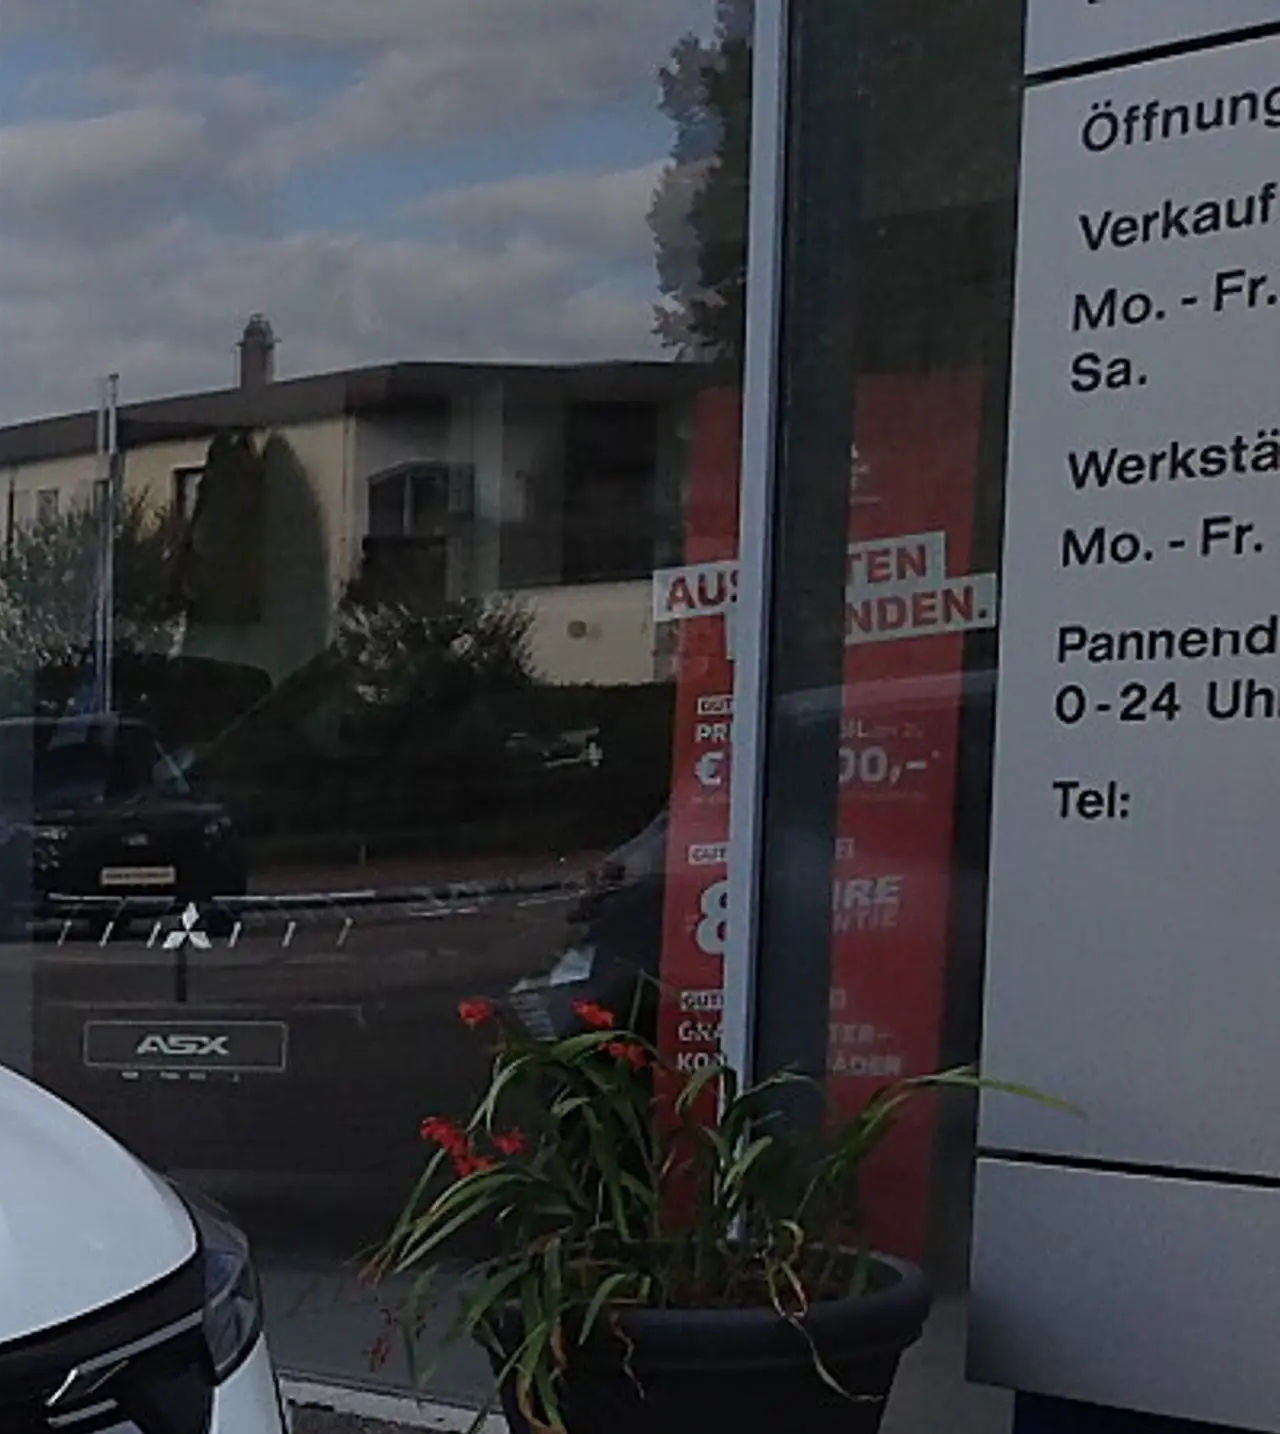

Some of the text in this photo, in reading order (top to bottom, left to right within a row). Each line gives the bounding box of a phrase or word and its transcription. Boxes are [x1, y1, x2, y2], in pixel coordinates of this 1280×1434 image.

[1078, 181, 1278, 252] Verkauf
[1070, 287, 1167, 333] Mo.
[1212, 269, 1279, 313] Fr.
[1069, 351, 1148, 393] Sa.
[1061, 525, 1154, 568] Mo.
[1199, 515, 1264, 557] Fr.
[1056, 614, 1278, 664] Pannend
[1205, 677, 1280, 720] Uh
[1052, 780, 1130, 821] Tel:
[135, 1034, 231, 1056] ASX
